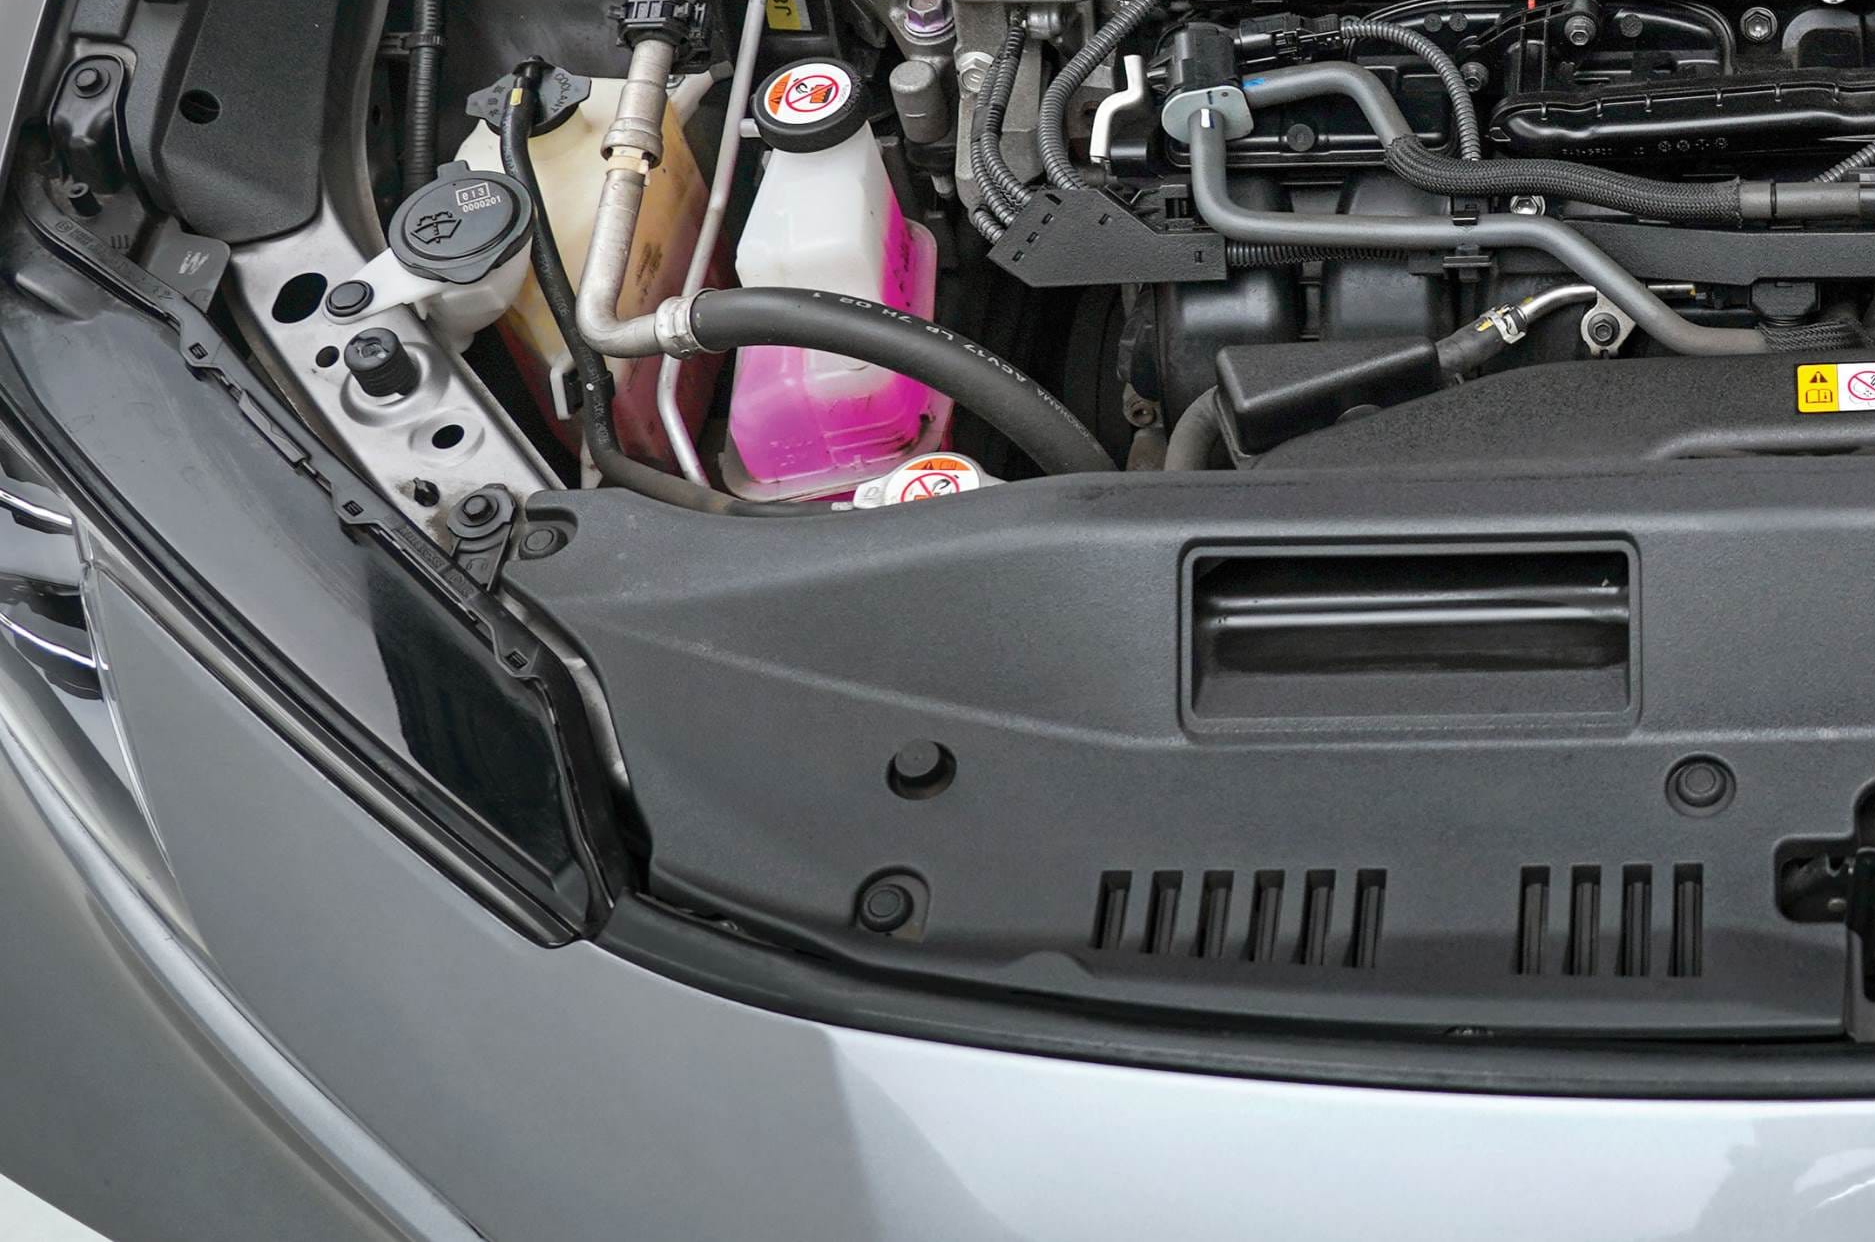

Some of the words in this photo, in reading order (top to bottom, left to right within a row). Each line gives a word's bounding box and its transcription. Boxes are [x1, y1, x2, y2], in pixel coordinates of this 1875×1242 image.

[552, 73, 572, 113] COOLANT
[462, 196, 501, 212] 0000201
[963, 343, 1027, 383] ACV17
